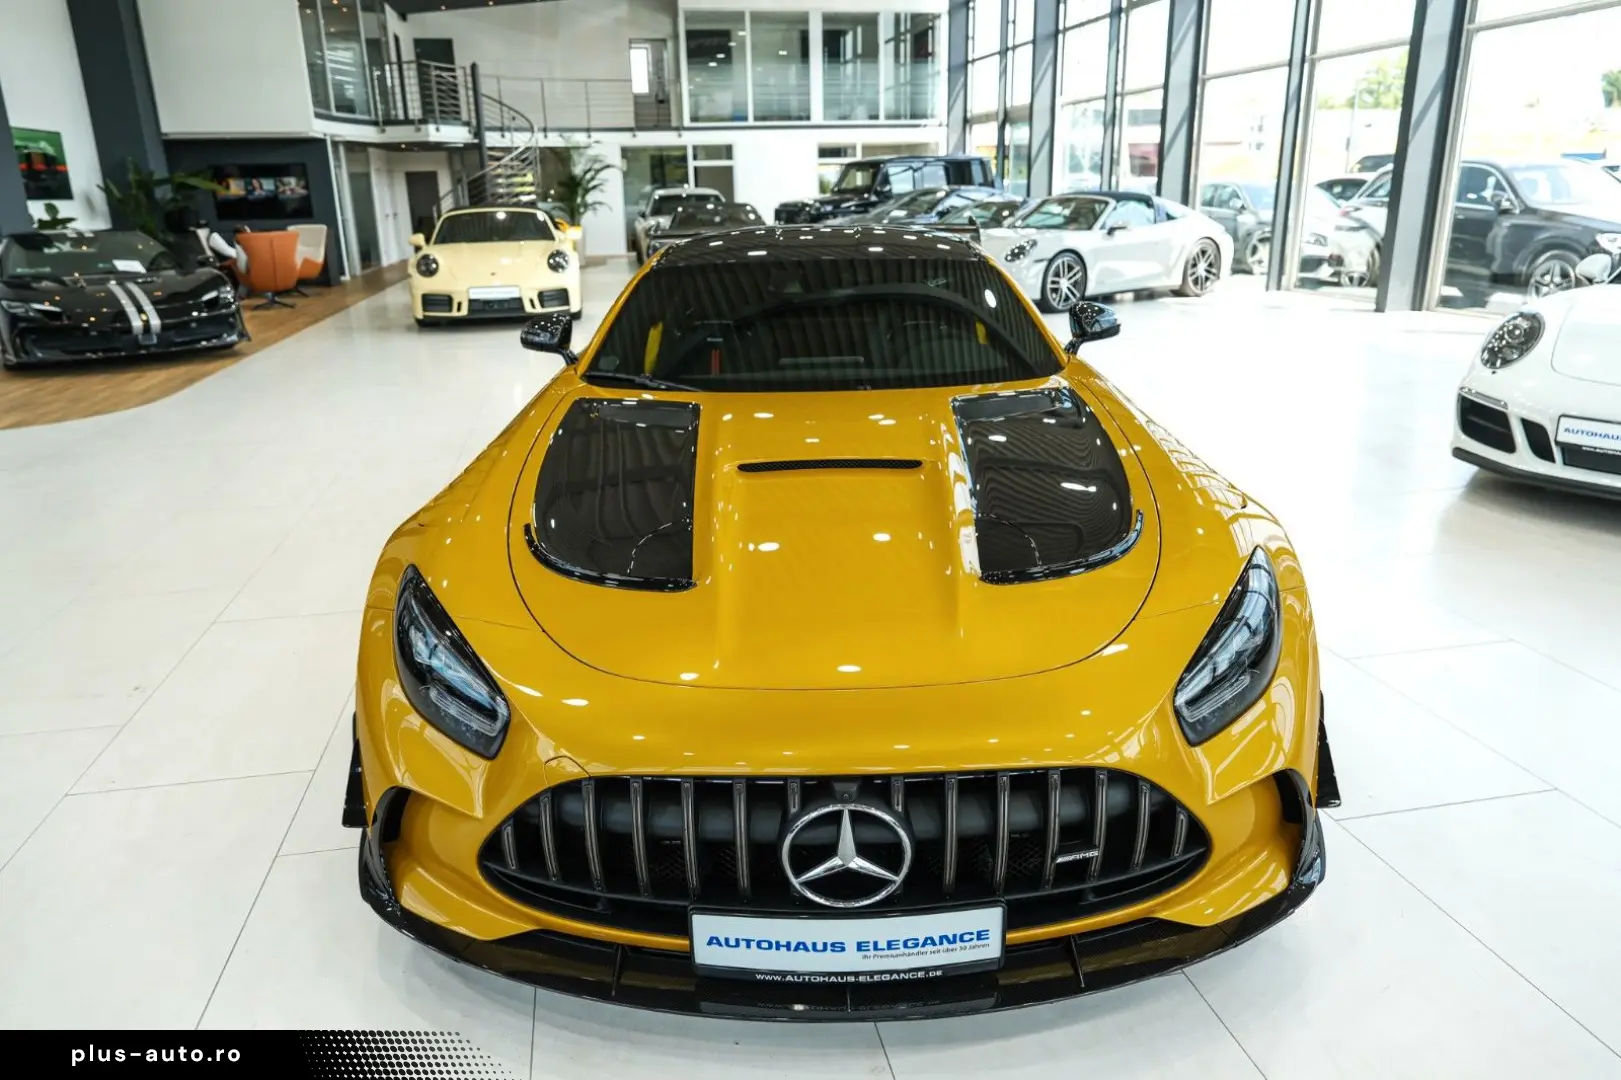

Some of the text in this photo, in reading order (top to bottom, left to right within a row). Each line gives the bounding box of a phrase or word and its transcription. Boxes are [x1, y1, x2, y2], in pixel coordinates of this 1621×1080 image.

[1563, 427, 1621, 441] AUTOHAU
[706, 929, 990, 953] AUTOHAUS ELEGANCE
[872, 950, 928, 960] Premiumhändler
[929, 948, 941, 956] seit
[941, 946, 958, 954] über
[968, 942, 990, 950] Jahren
